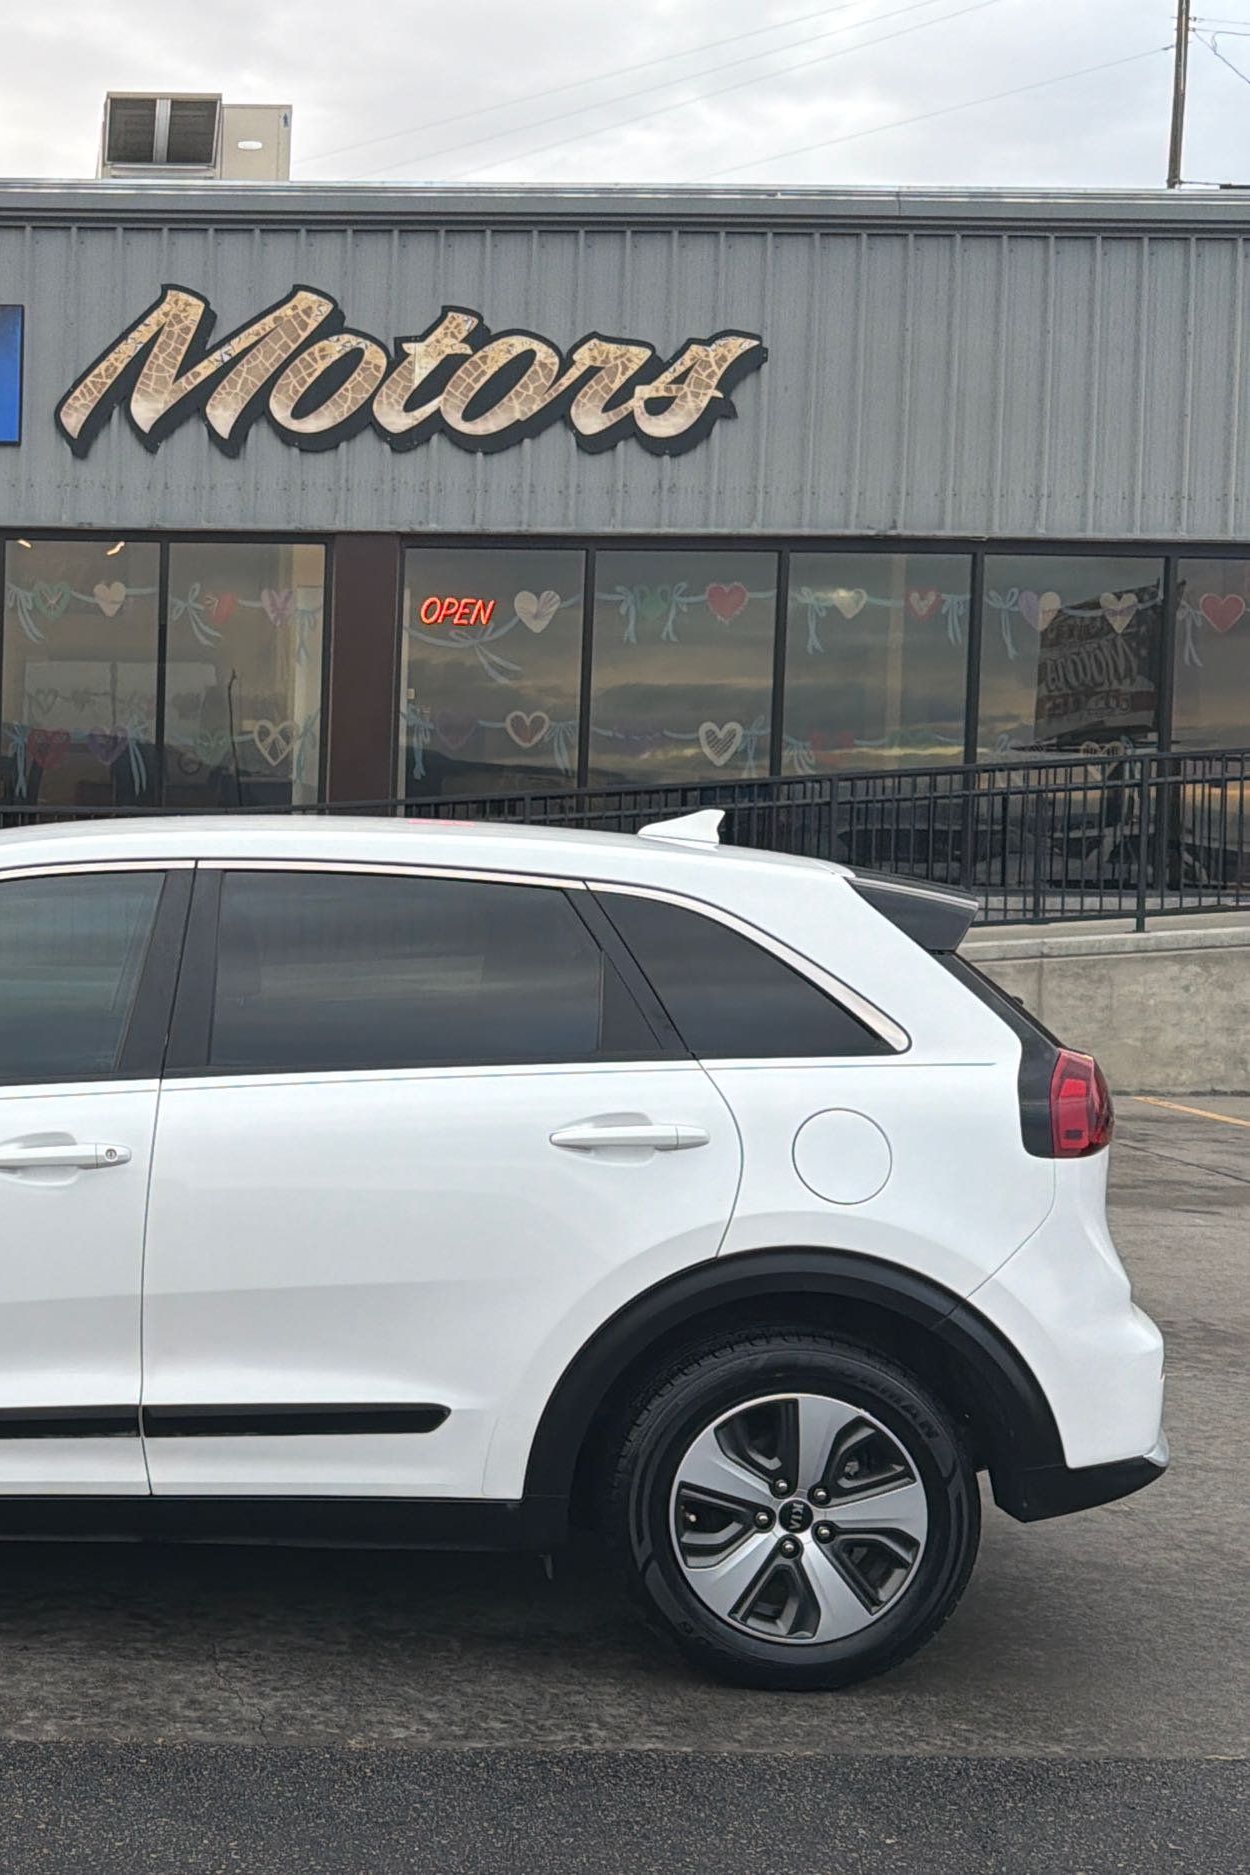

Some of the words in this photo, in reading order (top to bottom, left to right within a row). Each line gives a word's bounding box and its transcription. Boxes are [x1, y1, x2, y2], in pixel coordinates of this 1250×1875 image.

[56, 285, 766, 453] Motors
[419, 596, 496, 626] OPEN
[789, 1502, 804, 1530] KIA
